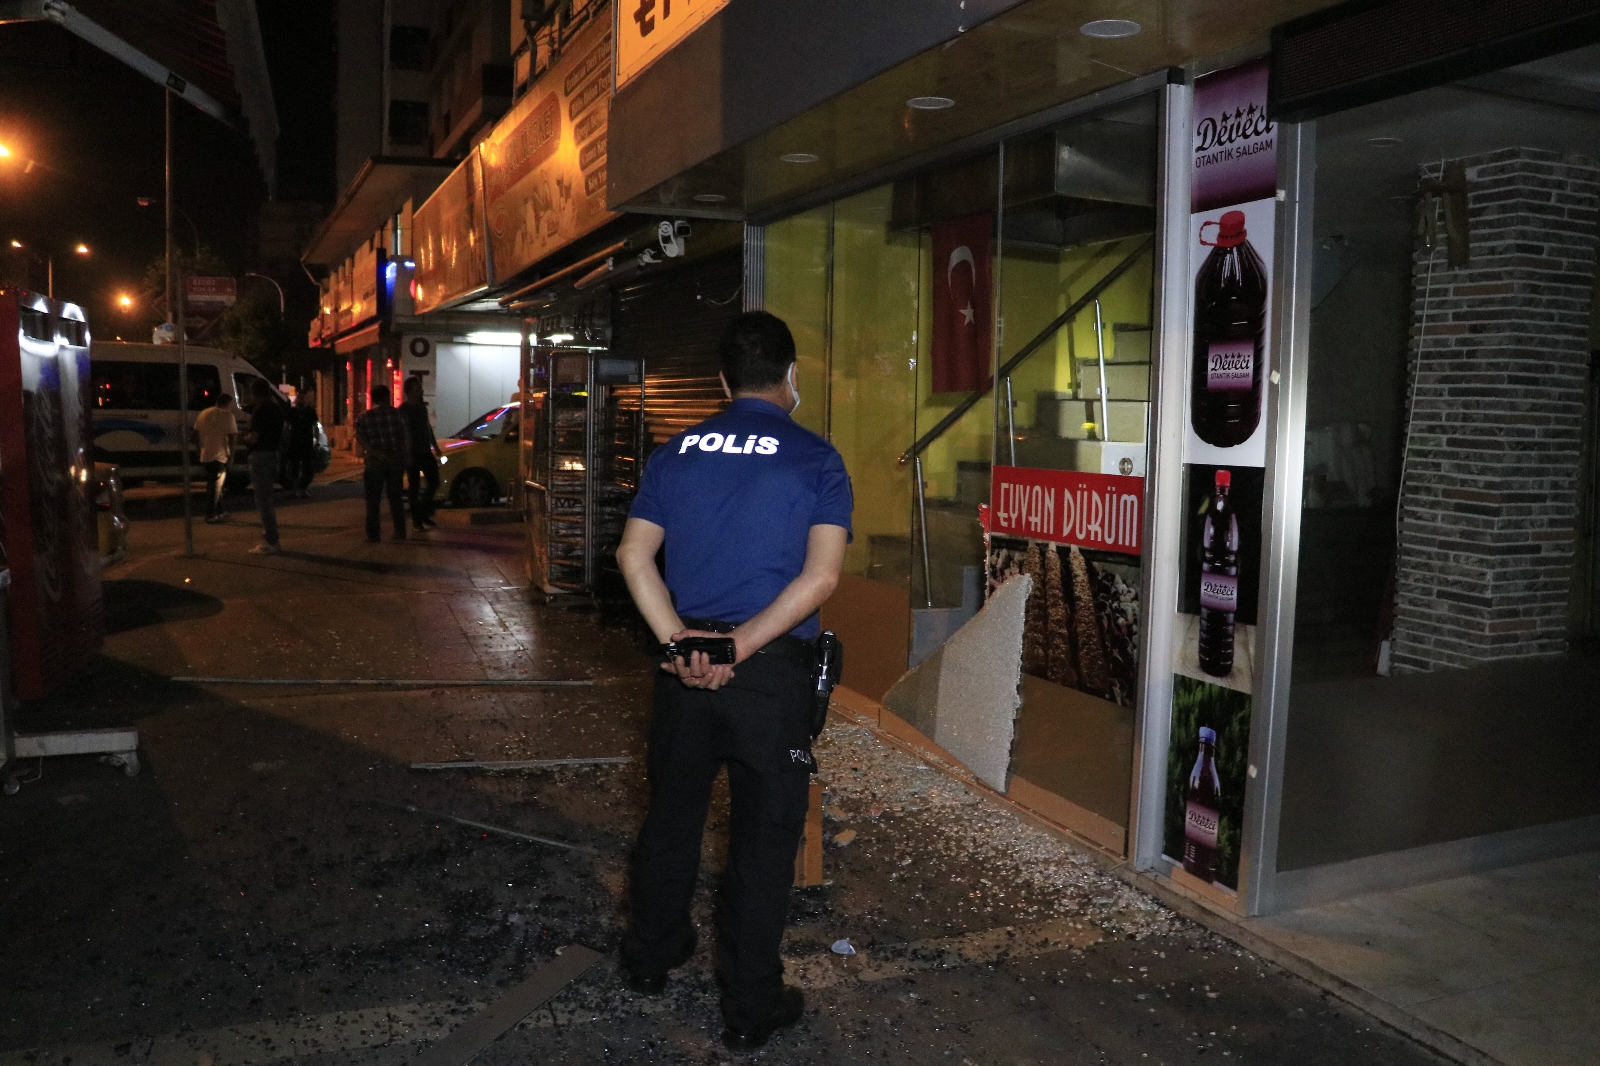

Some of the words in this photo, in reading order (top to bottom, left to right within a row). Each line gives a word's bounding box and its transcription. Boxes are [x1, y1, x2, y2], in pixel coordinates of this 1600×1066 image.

[1195, 106, 1274, 153] Deveci
[1195, 147, 1234, 168] OTANTİK
[1235, 139, 1273, 161] ŞALGAM
[1210, 354, 1251, 371] Deveci
[997, 482, 1056, 534] EYVAN
[1062, 484, 1138, 547] DÜRÜM
[1203, 581, 1234, 596] Deveci
